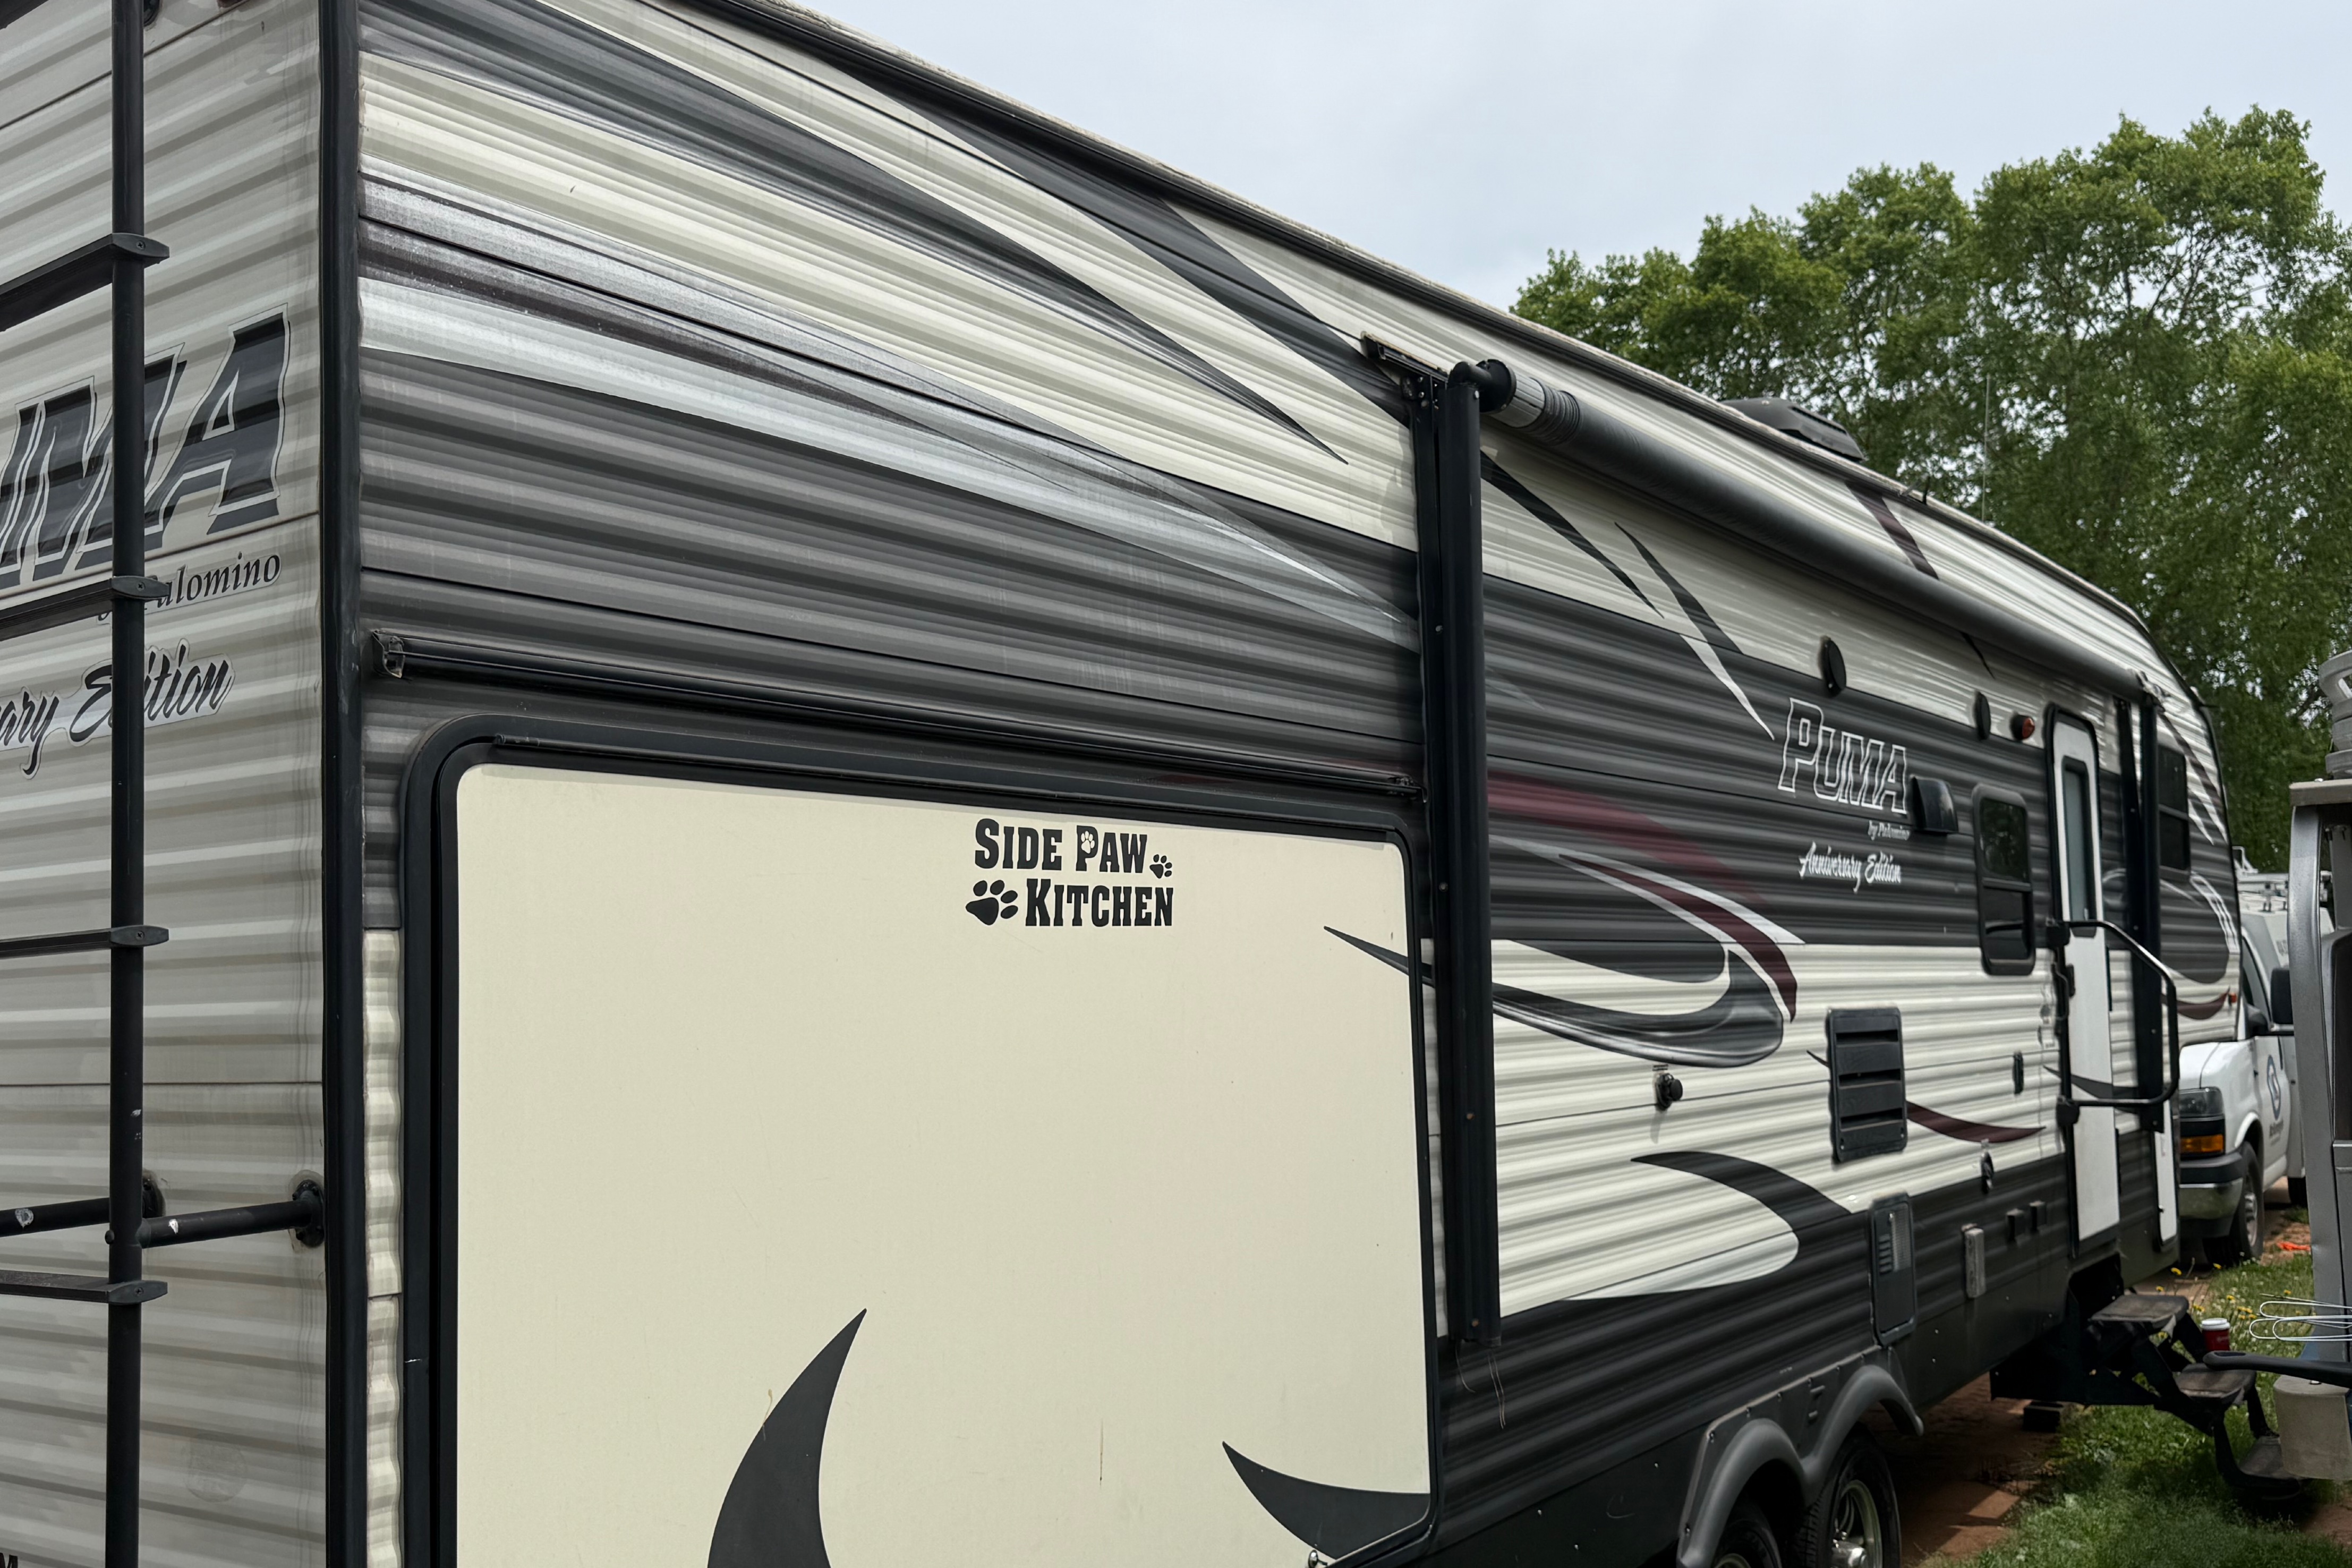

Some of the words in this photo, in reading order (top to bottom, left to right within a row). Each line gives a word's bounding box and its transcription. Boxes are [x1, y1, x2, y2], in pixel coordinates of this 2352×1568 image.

[144, 551, 280, 610] alomino
[70, 644, 232, 742] Eition
[1777, 697, 1907, 814] PUMA
[1799, 841, 1862, 893] Anniversary
[1864, 850, 1901, 884] Edition
